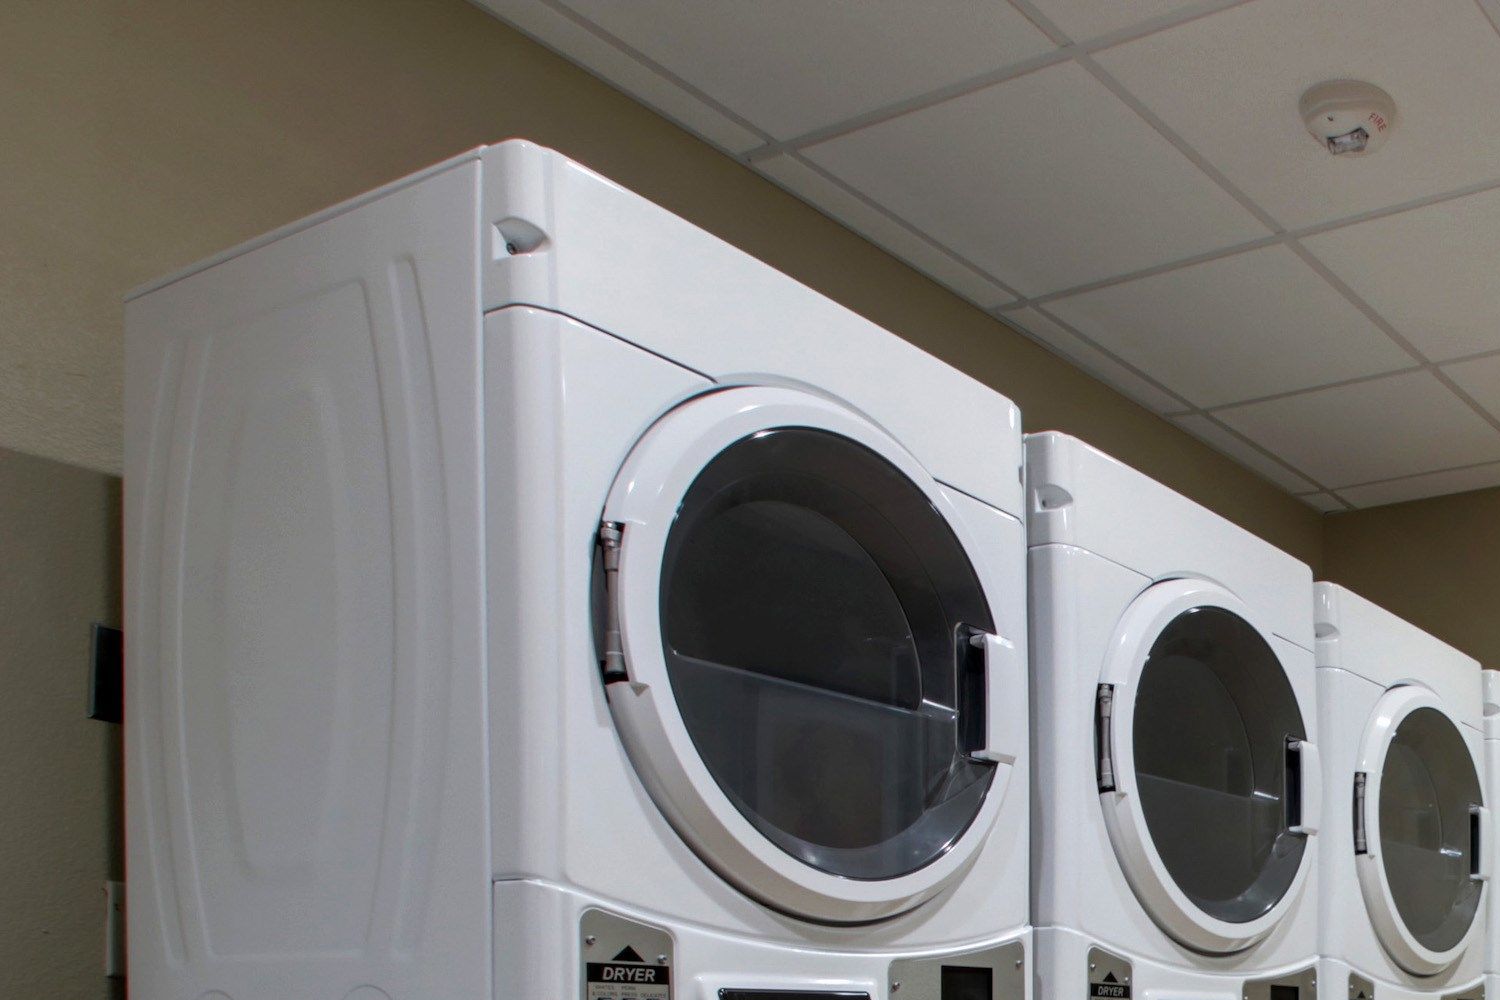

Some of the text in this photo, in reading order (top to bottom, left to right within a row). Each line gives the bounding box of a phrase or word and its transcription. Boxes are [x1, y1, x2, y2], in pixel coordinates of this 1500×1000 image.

[1368, 112, 1387, 133] FIRE
[602, 966, 656, 982] DRYER
[1097, 985, 1125, 997] DRYER
